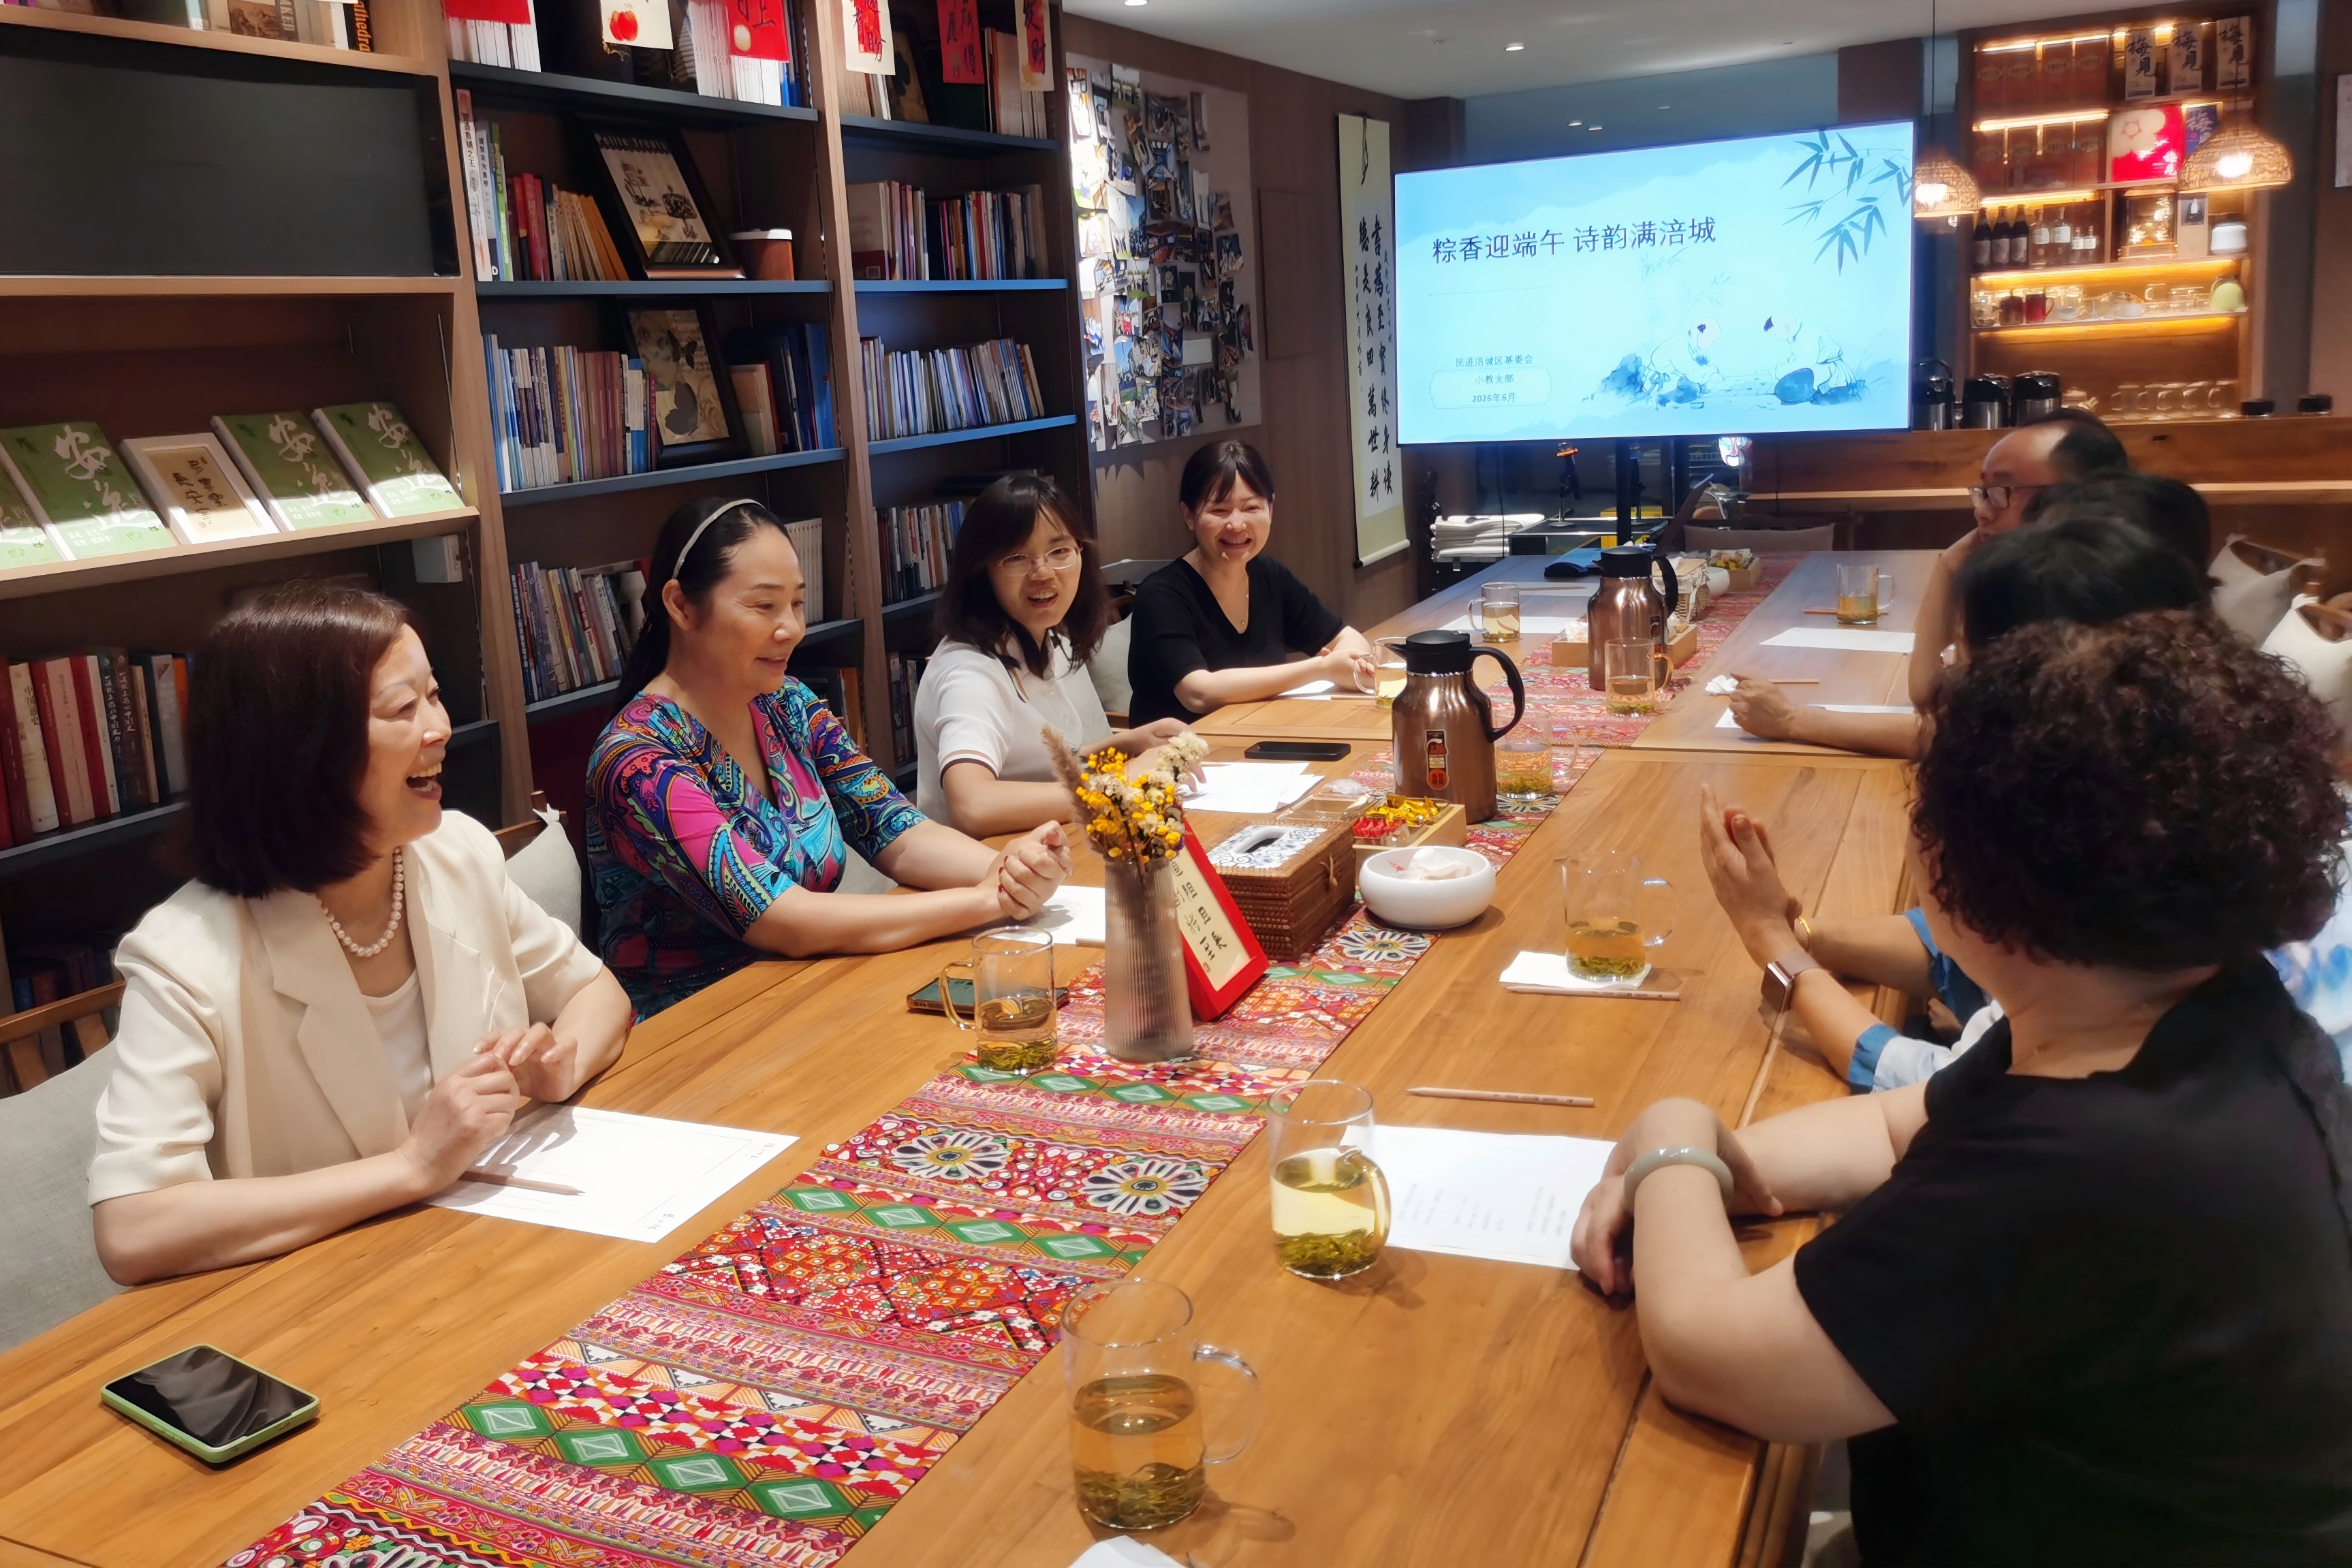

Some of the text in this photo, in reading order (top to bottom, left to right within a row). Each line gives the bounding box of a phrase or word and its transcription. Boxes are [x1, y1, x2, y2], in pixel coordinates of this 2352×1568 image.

[1432, 216, 1716, 264] 粽香迎端午 诗韵满涪城
[1475, 374, 1514, 385] 小教支部
[1472, 393, 1515, 403] 2026年6月
